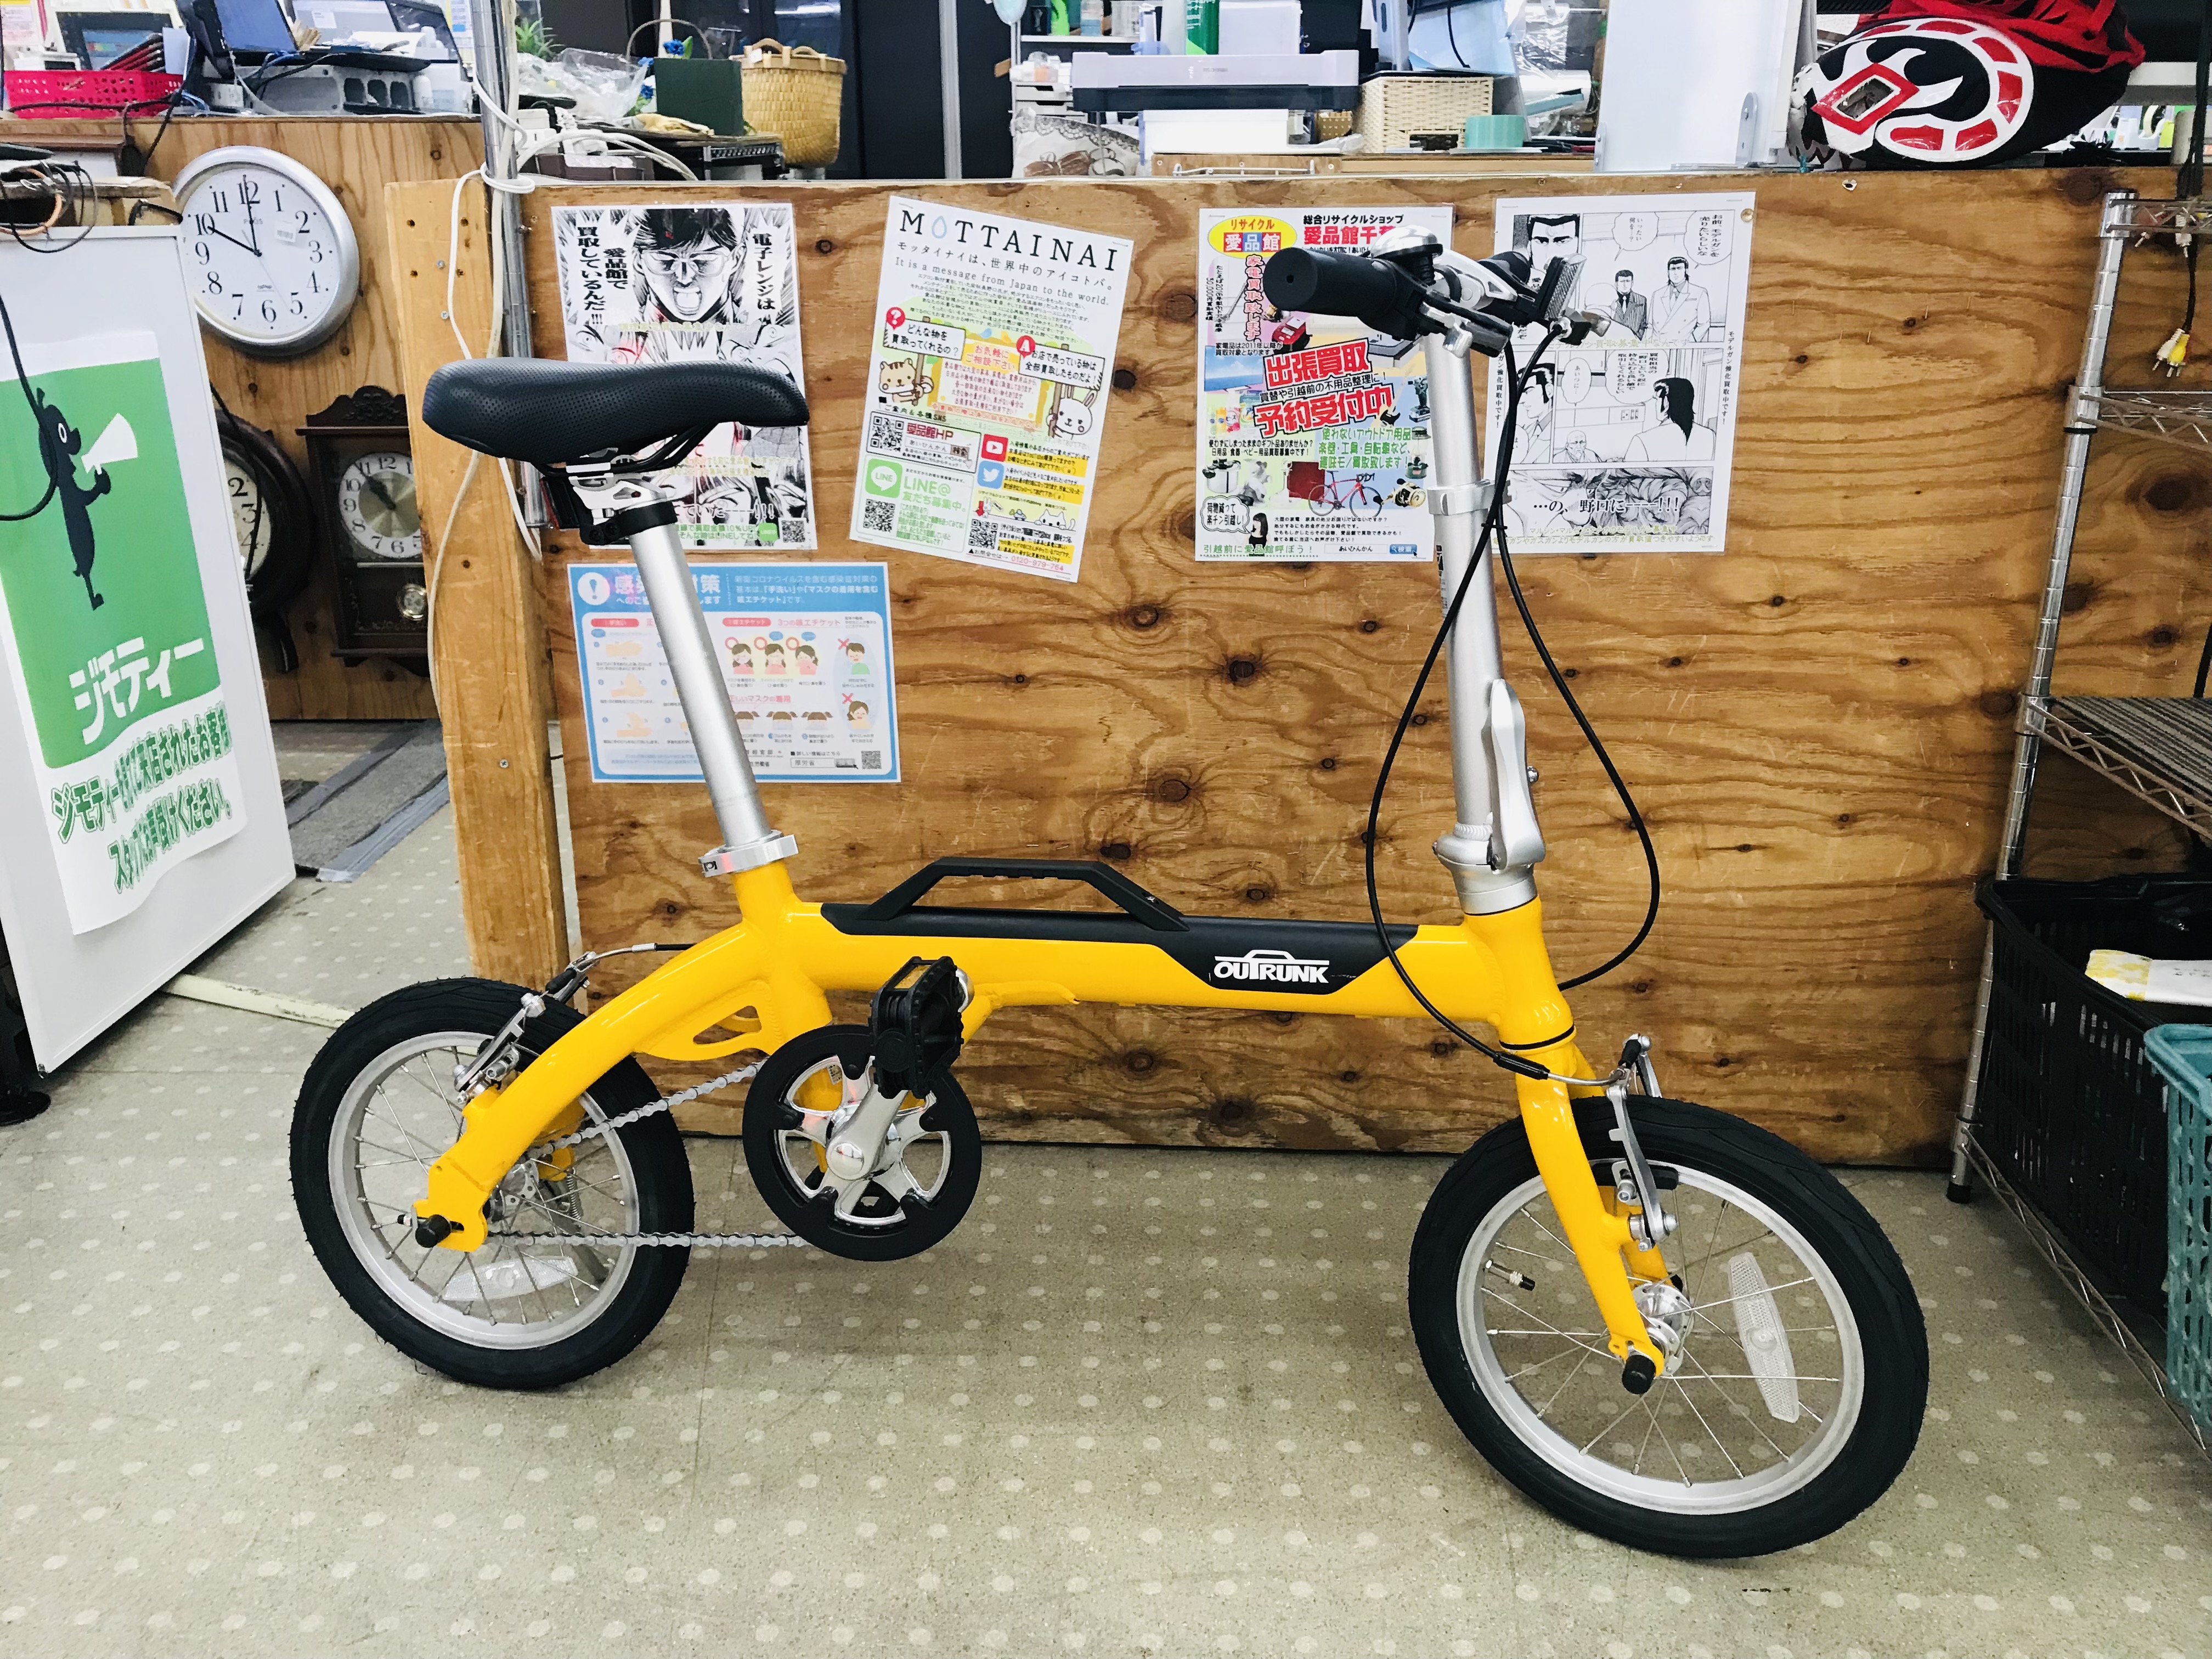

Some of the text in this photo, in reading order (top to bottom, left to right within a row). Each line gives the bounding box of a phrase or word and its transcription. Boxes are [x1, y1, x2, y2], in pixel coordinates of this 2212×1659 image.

[212, 191, 229, 213] 11
[238, 181, 260, 205] 12
[274, 190, 284, 212] 1
[194, 213, 215, 235] 10
[295, 210, 310, 233] 2
[1231, 218, 1275, 230] リサイクル
[1303, 214, 1404, 224] 総合リサイクルショップ
[309, 240, 323, 263] 3
[1224, 232, 1282, 252] 愛品館
[195, 241, 210, 265] 9
[603, 247, 628, 289] 愛品館で
[752, 233, 776, 310] 電子レンジは
[207, 271, 222, 295] 8
[306, 270, 320, 293] 4
[895, 257, 905, 267] It
[908, 259, 917, 270] is
[932, 266, 977, 283] message
[981, 272, 1006, 286] from
[1009, 278, 1039, 292] Japan
[1043, 284, 1053, 294] to
[1057, 285, 1073, 298] the
[1078, 291, 1109, 306] world.
[232, 294, 244, 316] 7
[261, 300, 276, 323] 6
[290, 292, 303, 315] 5
[907, 324, 948, 341] どんな物を
[892, 334, 960, 357] 買取ってくれるの?
[974, 345, 1009, 359] お気軽に
[1019, 339, 1031, 353] A
[966, 353, 1015, 370] ご相談下さい
[1031, 350, 1097, 371] お店で売っている物は
[1266, 341, 1370, 387] 出張買取
[1722, 331, 1734, 425] モデルガン強化買取中です!
[1255, 385, 1393, 438] 予約受付中
[1322, 428, 1411, 441] 使わないアウトドア用品
[910, 440, 947, 452] あいひんかん
[379, 457, 397, 470] 12
[228, 477, 247, 497] 2
[345, 479, 361, 492] 10
[875, 472, 893, 482] LINE
[904, 476, 951, 496] LINE@
[241, 503, 257, 524] 3
[343, 498, 357, 511] 9
[352, 520, 365, 533] 8
[1207, 515, 1244, 526] 楽チン引越し!
[371, 535, 383, 549] 7
[391, 541, 404, 553] 6
[1204, 544, 1312, 554] 引越前に愛品館呼ぼう!
[69, 636, 204, 745] ジモティー
[1214, 959, 1330, 984] OUTRUNK
